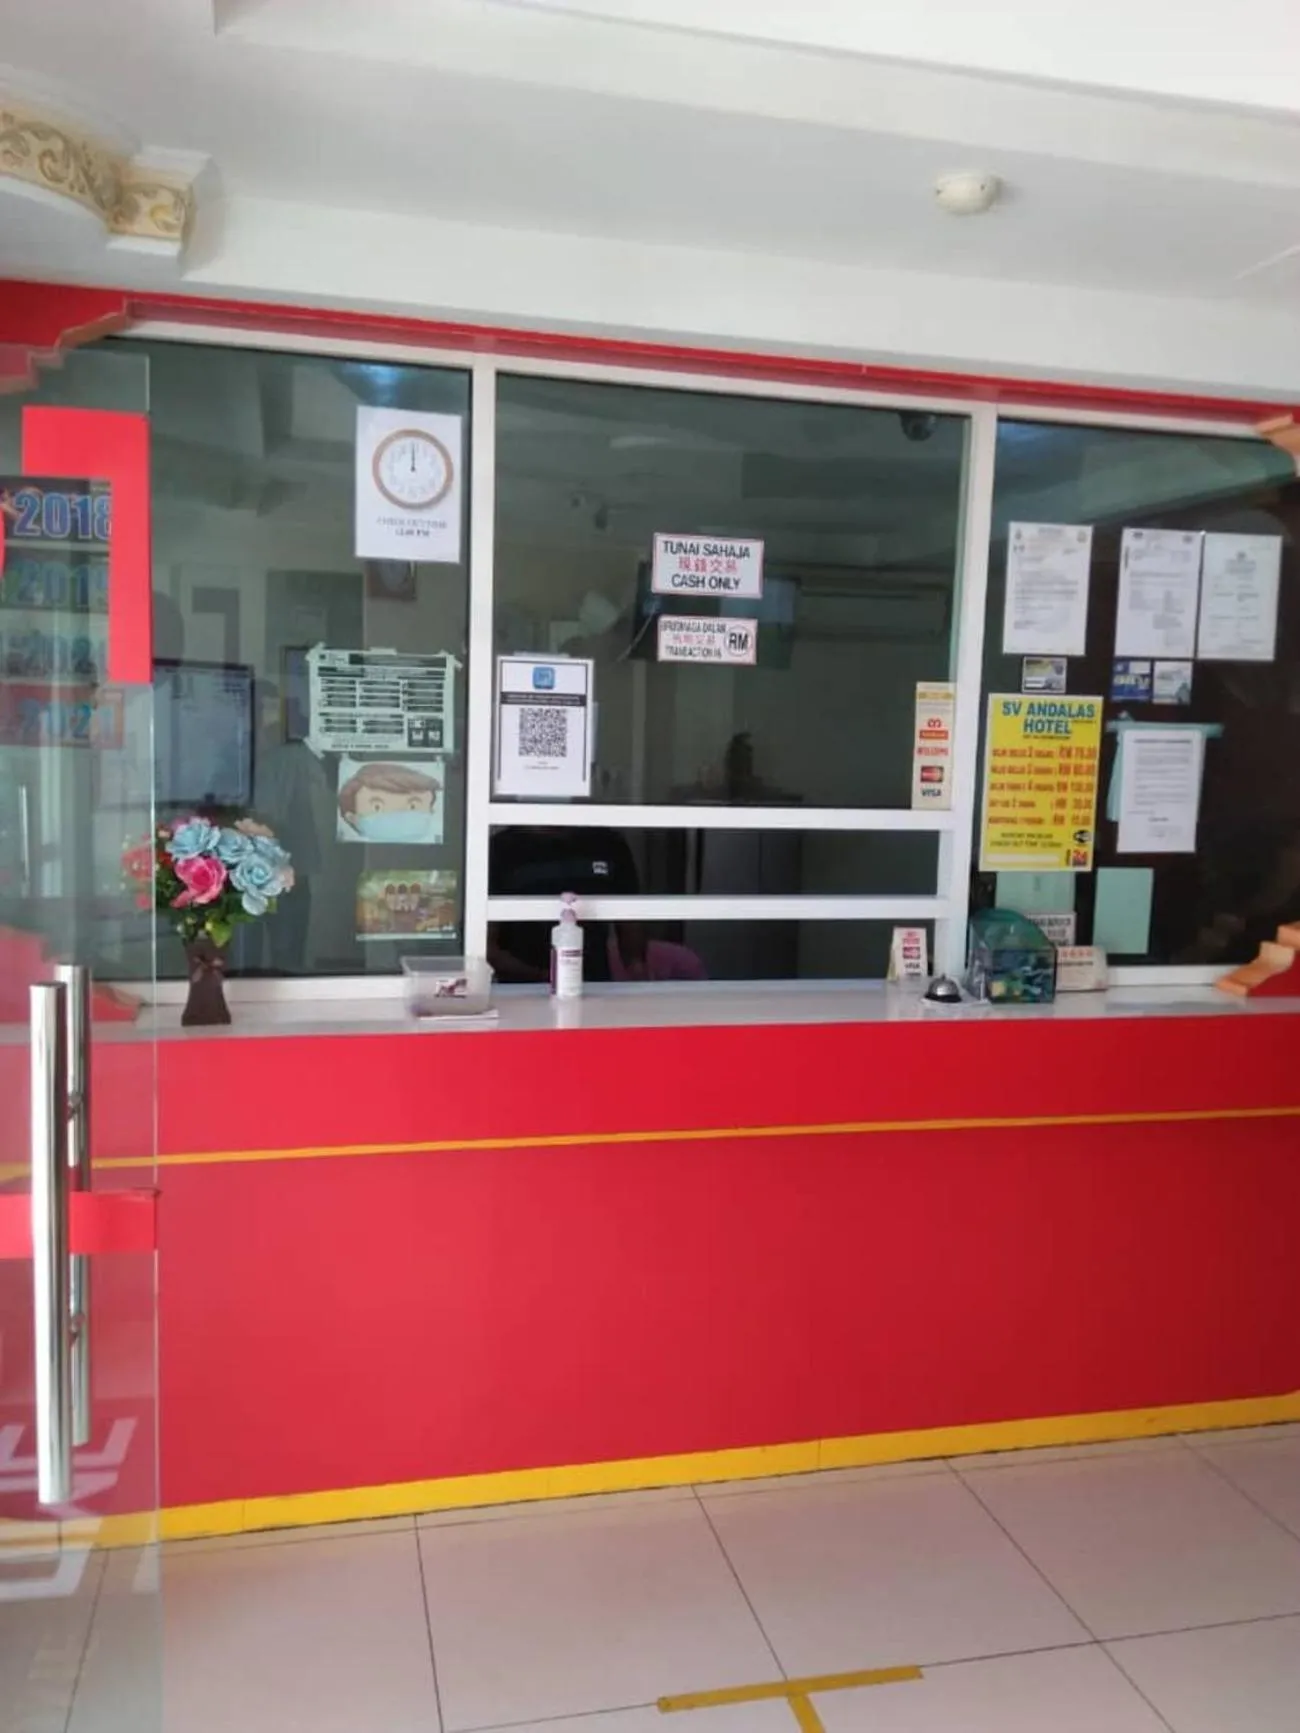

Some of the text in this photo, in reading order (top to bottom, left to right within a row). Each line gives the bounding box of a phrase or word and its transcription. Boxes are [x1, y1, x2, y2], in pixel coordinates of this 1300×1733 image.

[662, 540, 751, 559] TUNAI SAHAJA
[671, 574, 741, 591] CASH ONLY
[729, 632, 749, 651] RM
[1002, 700, 1096, 718] SV ANDALAS
[1023, 718, 1072, 735] HOTEL
[922, 788, 942, 798] VISA
